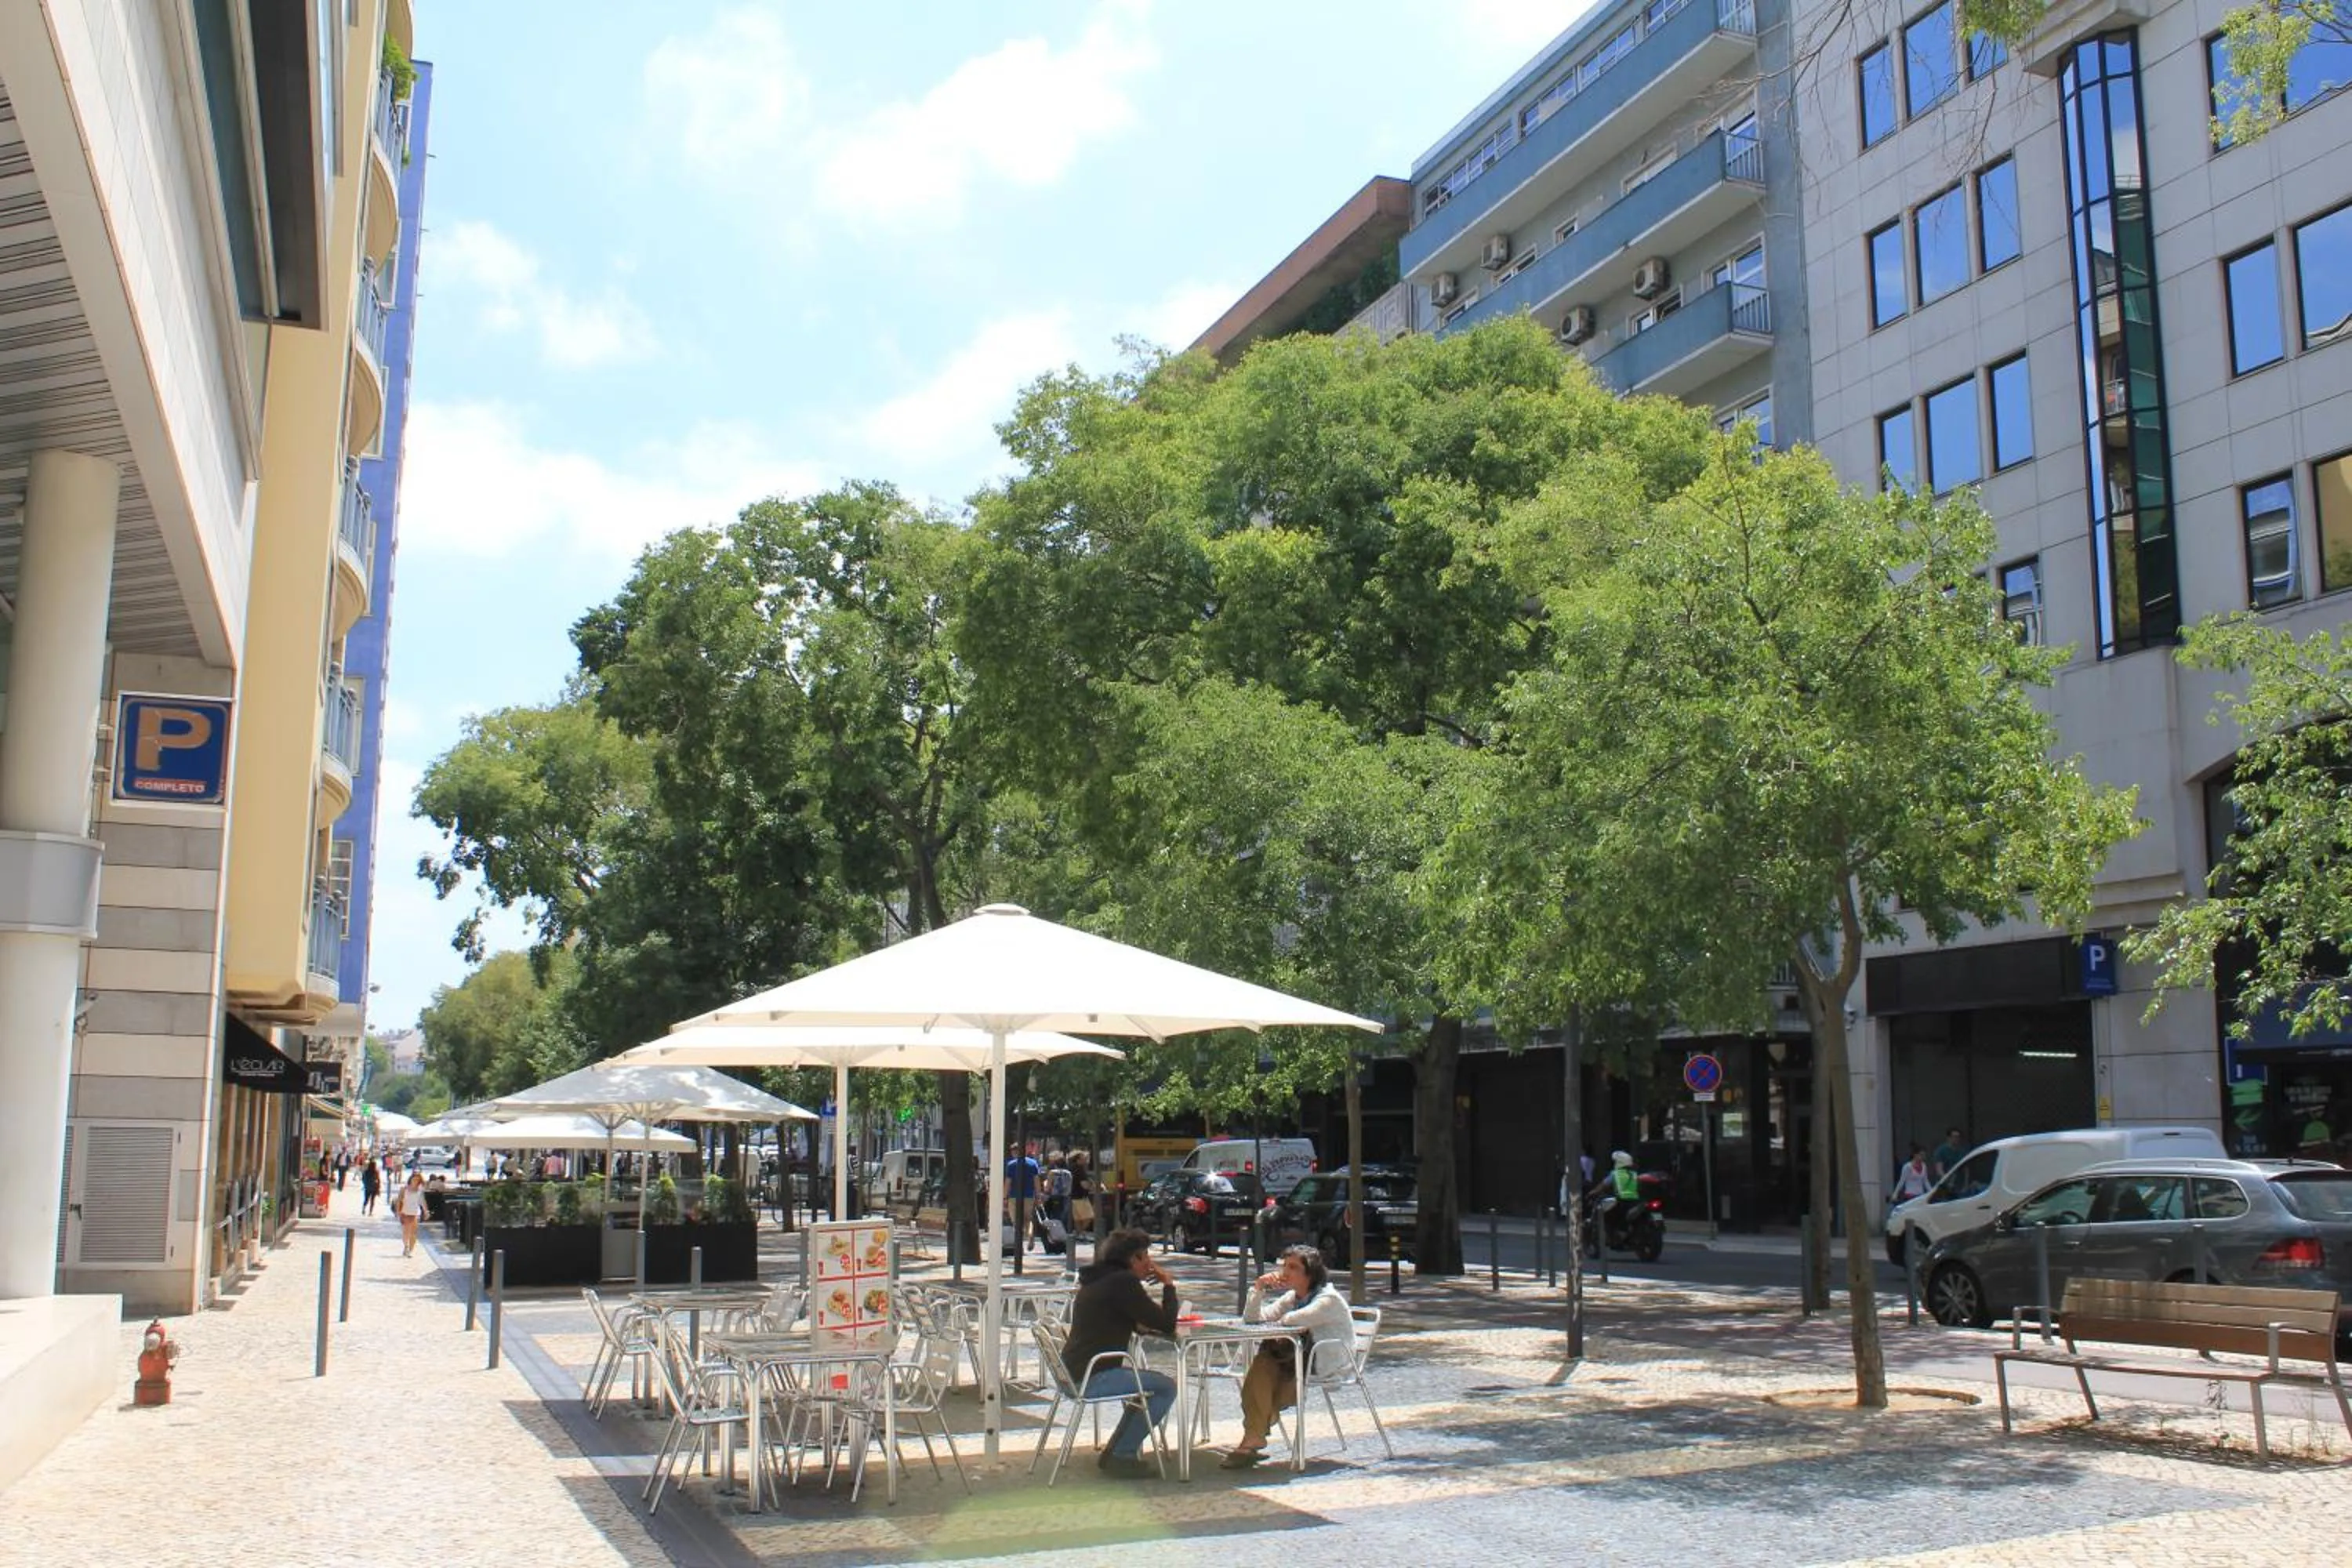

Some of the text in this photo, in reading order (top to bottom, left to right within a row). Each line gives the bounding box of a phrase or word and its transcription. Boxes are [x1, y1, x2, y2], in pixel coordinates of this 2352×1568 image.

[136, 707, 212, 771] P
[134, 779, 205, 793] COMPLETO
[2090, 945, 2105, 971] P
